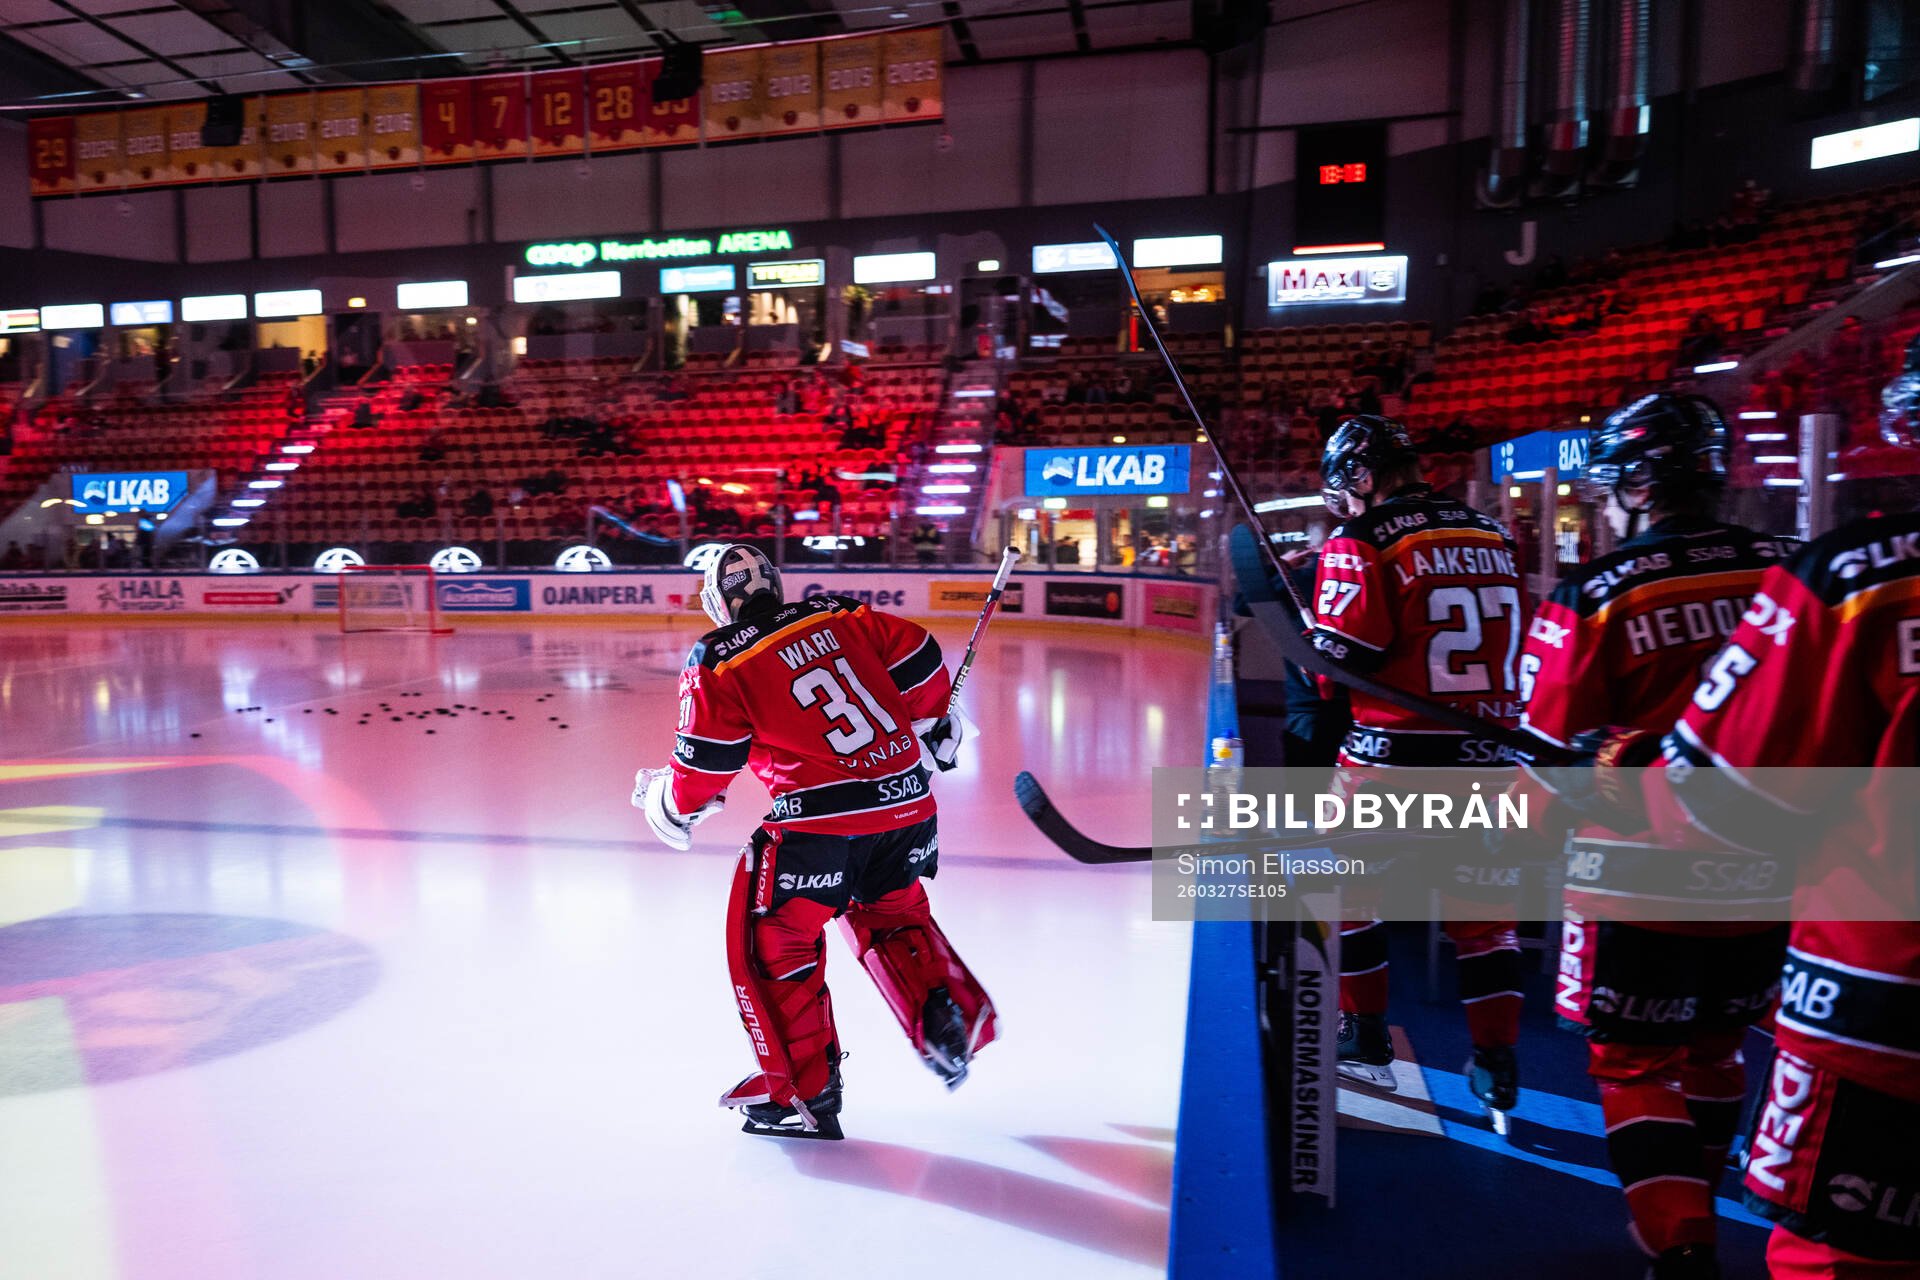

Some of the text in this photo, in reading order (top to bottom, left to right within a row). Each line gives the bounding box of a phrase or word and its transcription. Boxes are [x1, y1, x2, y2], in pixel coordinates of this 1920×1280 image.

[438, 103, 455, 134] 4
[491, 96, 508, 129] 7
[545, 92, 572, 126] 12
[597, 86, 634, 121] 28
[717, 230, 792, 253] ARENA
[1506, 221, 1536, 266] J
[1283, 269, 1361, 289] MAXI
[1076, 454, 1166, 488] LKAB
[107, 479, 169, 505] LKAB
[722, 570, 747, 591] SSAB
[1601, 552, 1673, 587] LKAB
[119, 580, 184, 599] HALA
[543, 584, 655, 605] OJANPERÄ
[1317, 579, 1362, 617] 27
[727, 625, 760, 651] LKAB
[777, 627, 842, 672] WARD
[1428, 586, 1521, 694] 27
[790, 655, 899, 757] 31
[877, 774, 923, 802] SSAB
[796, 871, 843, 890] LKAB
[1686, 860, 1779, 892] SSAB
[735, 985, 770, 1057] BAUER
[1621, 996, 1698, 1023] LKAB
[1295, 969, 1322, 1188] NORRMASKINER
